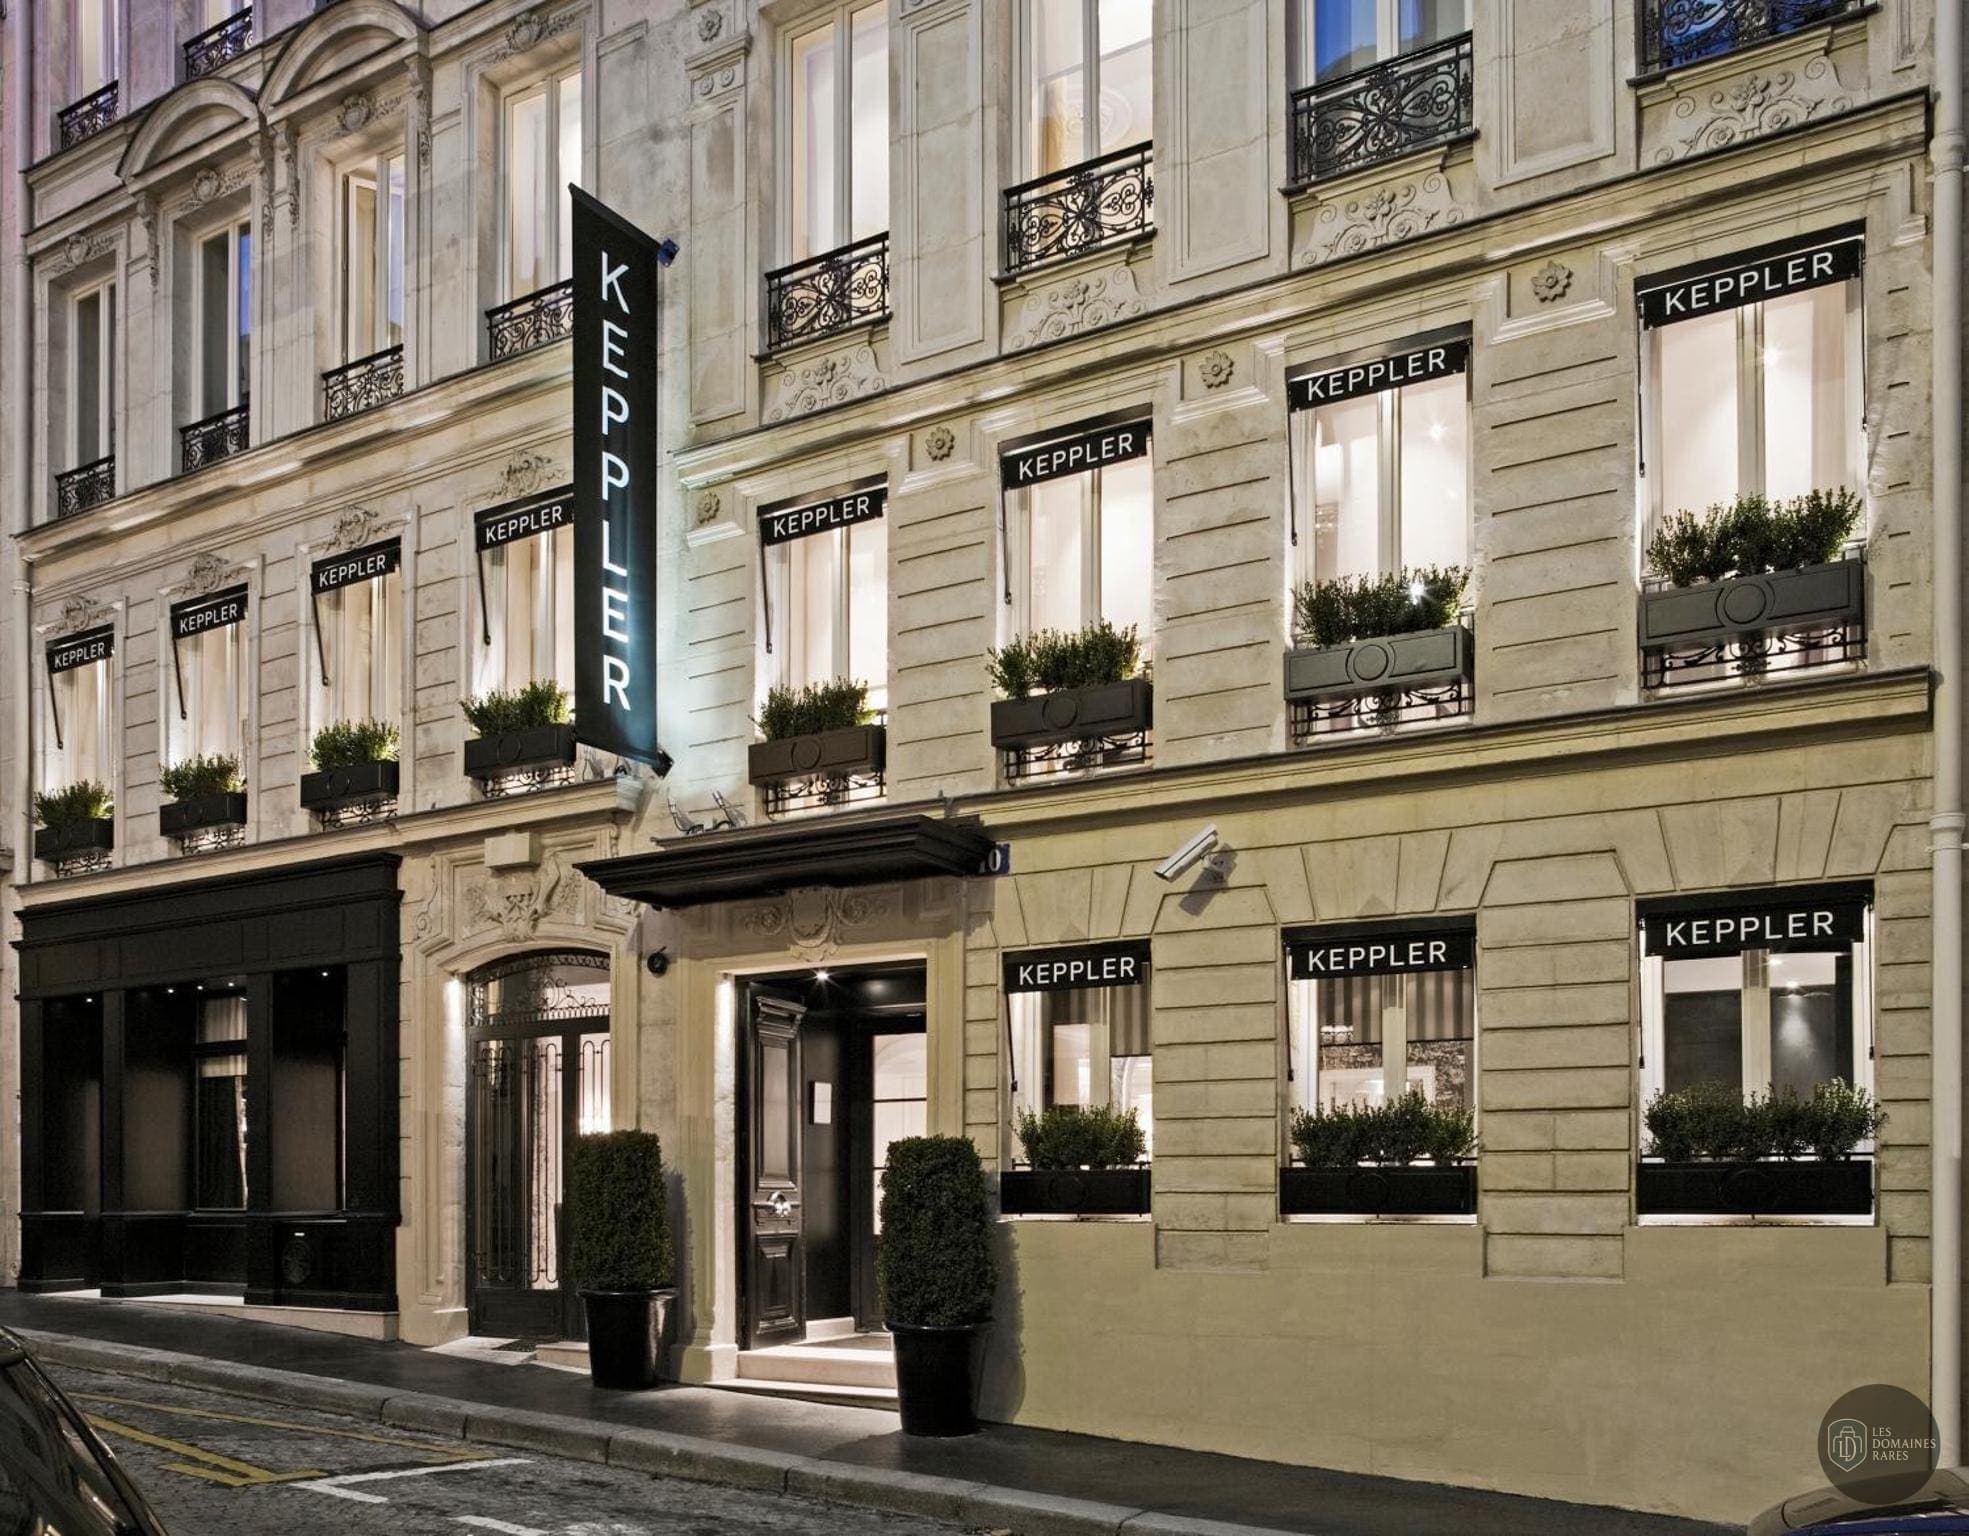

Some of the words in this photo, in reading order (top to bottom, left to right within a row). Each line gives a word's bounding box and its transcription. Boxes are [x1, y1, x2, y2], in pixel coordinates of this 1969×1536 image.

[1665, 251, 1834, 315] KEPPLER
[1308, 348, 1446, 401] KEPPLER
[1019, 433, 1133, 480] KEPPLER
[601, 251, 631, 711] KEPPLER
[486, 505, 562, 544] KEPPLER
[773, 496, 870, 538] KEPPLER
[319, 554, 386, 587] KEPPLER
[180, 603, 237, 633] KEPPLER
[54, 642, 105, 668] KEPPLER
[1666, 911, 1834, 946] KEPPLER
[1019, 956, 1135, 985] KEPPLER
[1308, 941, 1447, 972] KEPPLER
